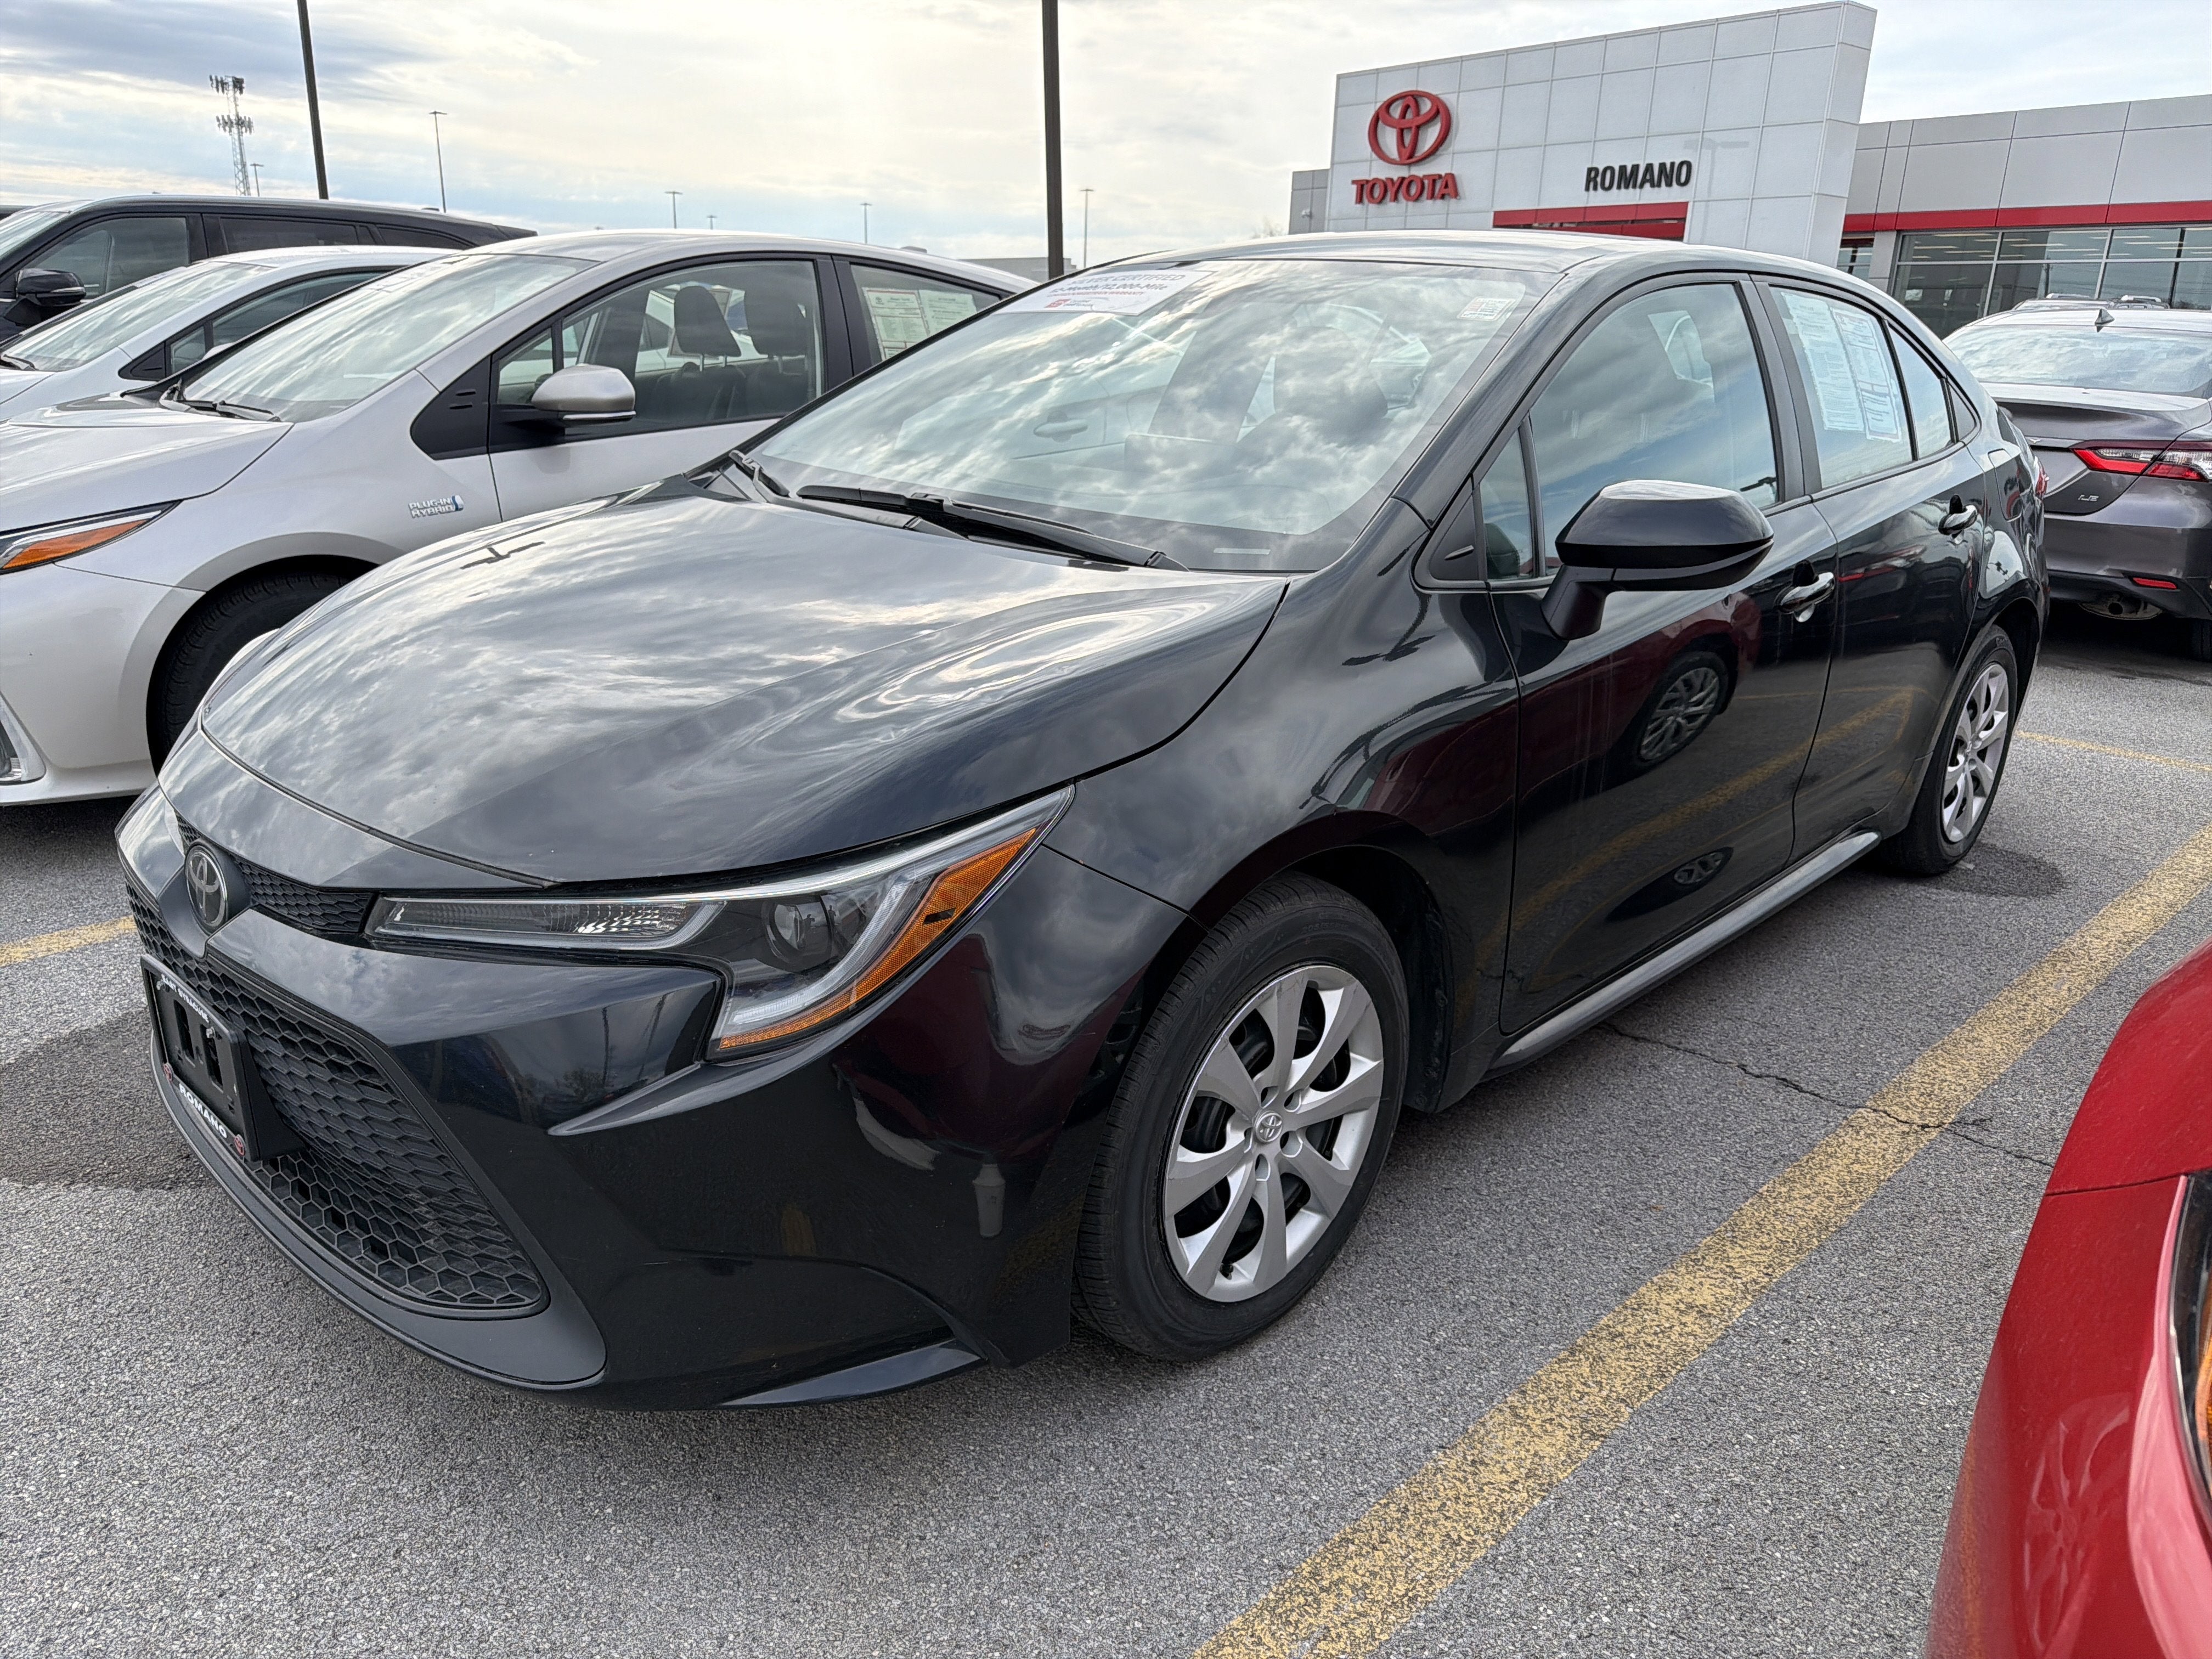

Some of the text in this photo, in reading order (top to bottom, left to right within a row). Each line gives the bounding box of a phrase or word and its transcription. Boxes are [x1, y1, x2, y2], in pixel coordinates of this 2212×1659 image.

[1351, 173, 1459, 205] TOYOTA
[1584, 160, 1692, 191] ROMANO
[409, 498, 451, 510] PLUG-IN
[411, 505, 455, 518] HYBRID
[179, 1083, 227, 1138] ROMANO
